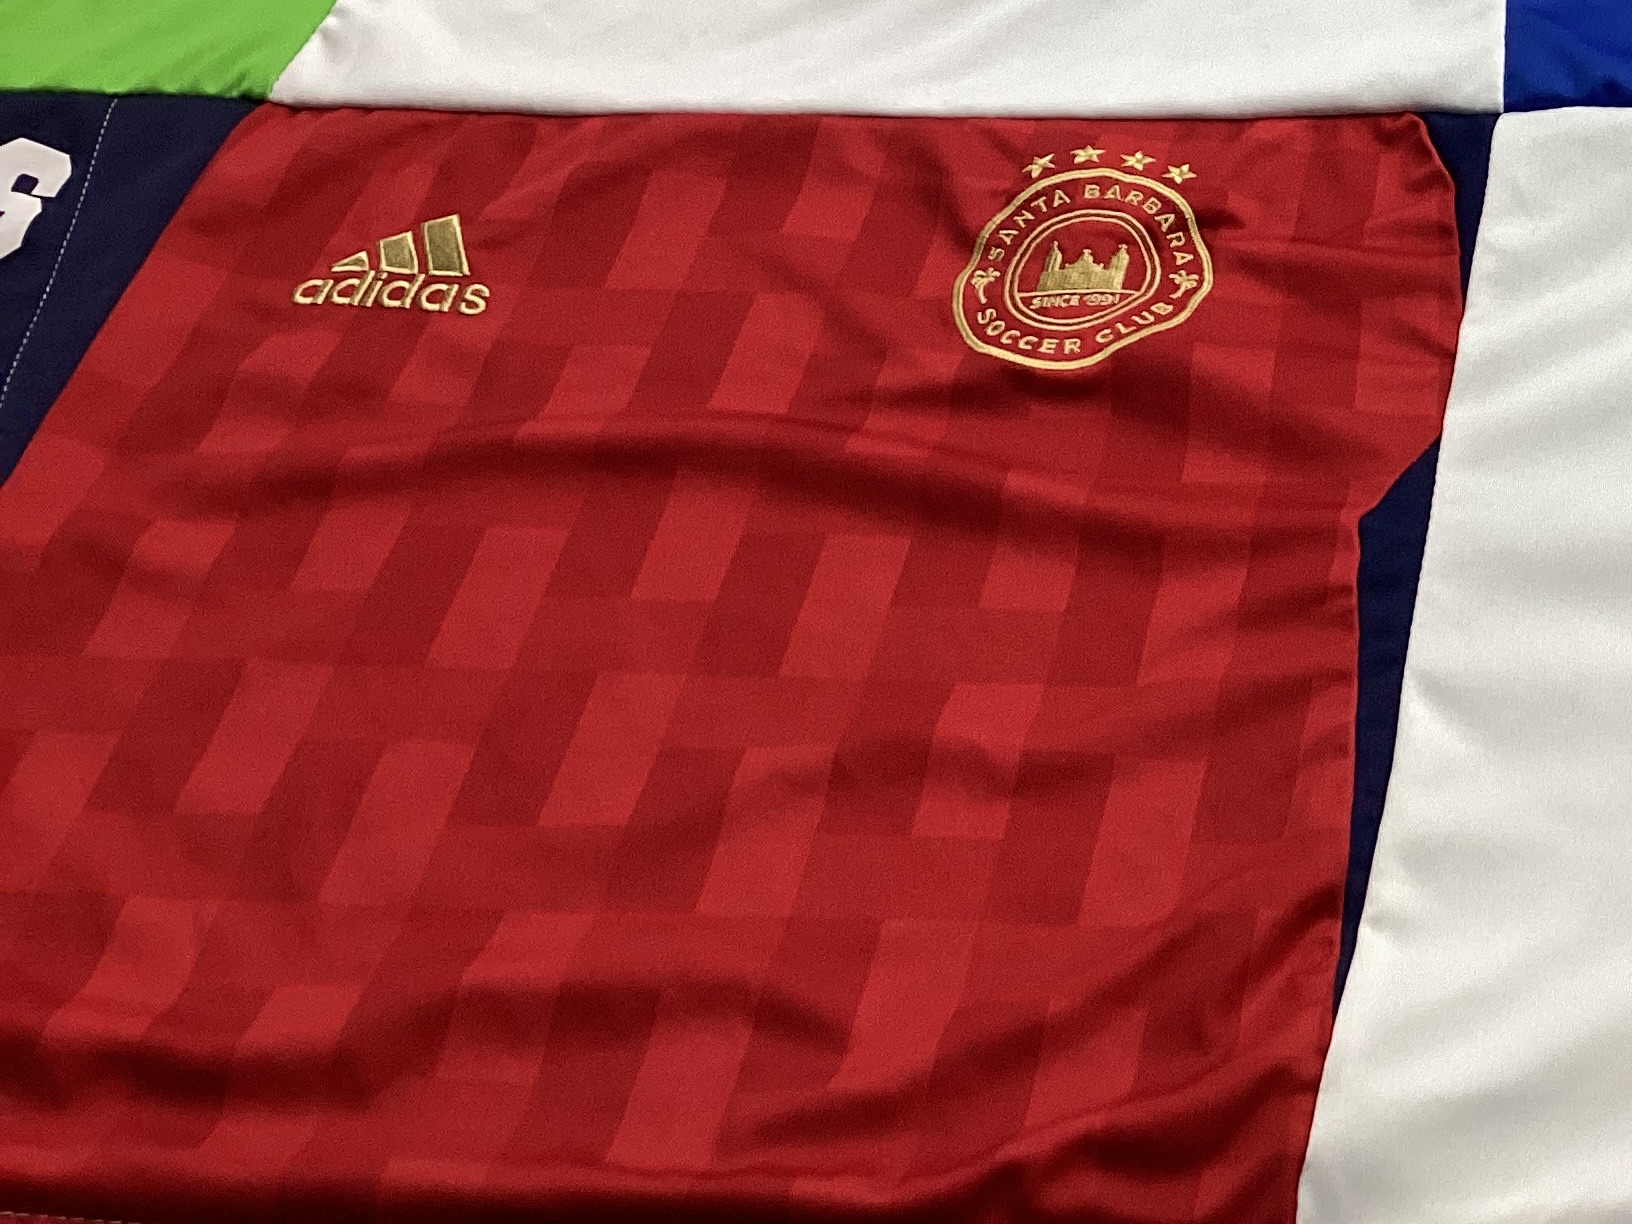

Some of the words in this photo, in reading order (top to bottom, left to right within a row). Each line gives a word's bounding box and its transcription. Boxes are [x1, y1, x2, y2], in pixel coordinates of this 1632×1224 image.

[988, 189, 1071, 262] SANTA
[1083, 183, 1195, 266] BARBARA
[293, 271, 491, 316] adidas
[976, 307, 1082, 355] SOCCER
